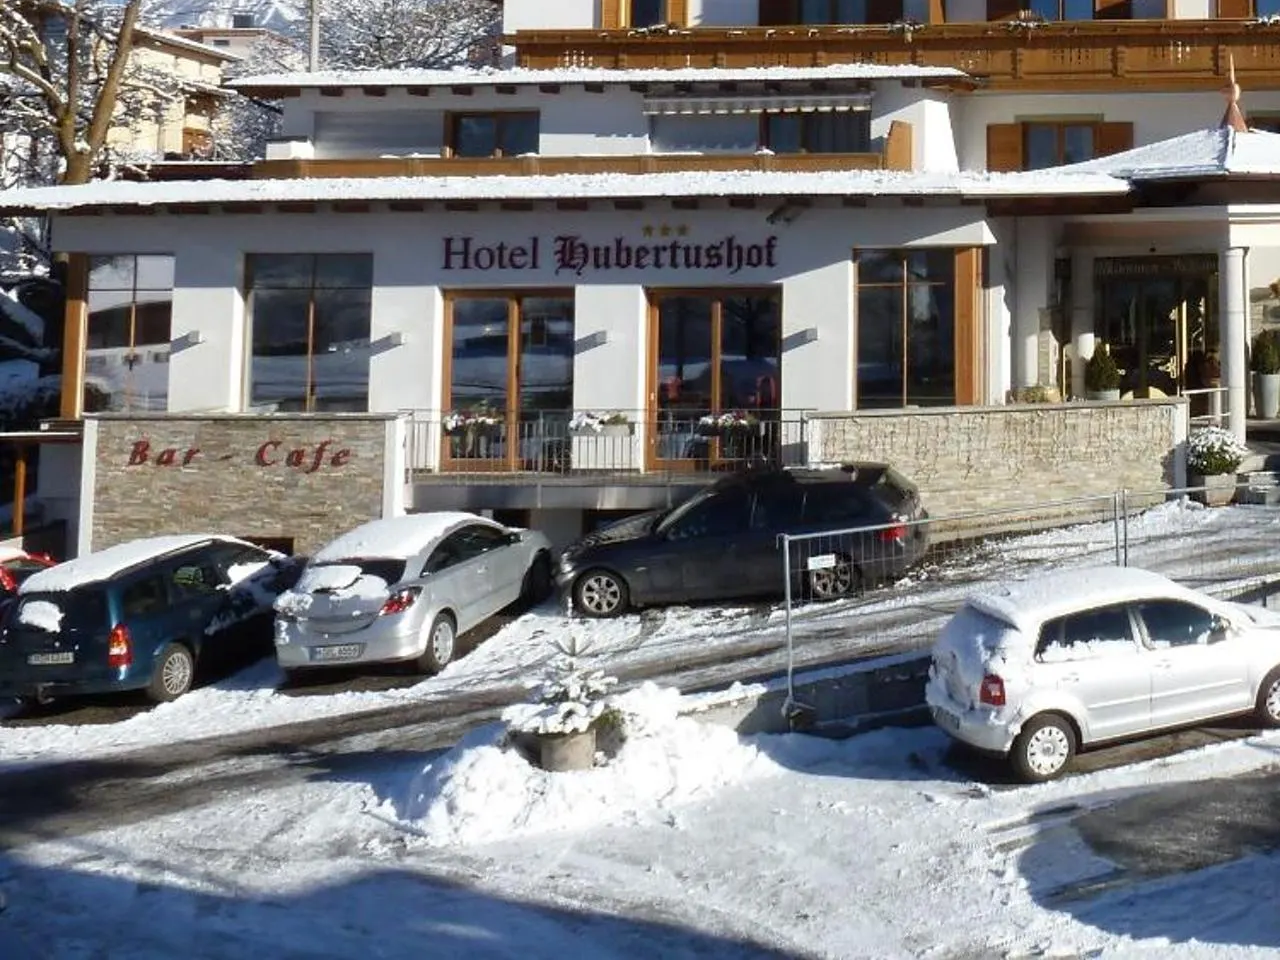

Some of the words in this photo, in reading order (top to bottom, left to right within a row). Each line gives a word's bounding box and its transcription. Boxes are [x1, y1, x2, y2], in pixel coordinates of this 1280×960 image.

[442, 236, 540, 270] Hotel
[554, 236, 778, 275] Hubertushof
[128, 440, 200, 467] Bar
[255, 439, 351, 474] Cafe
